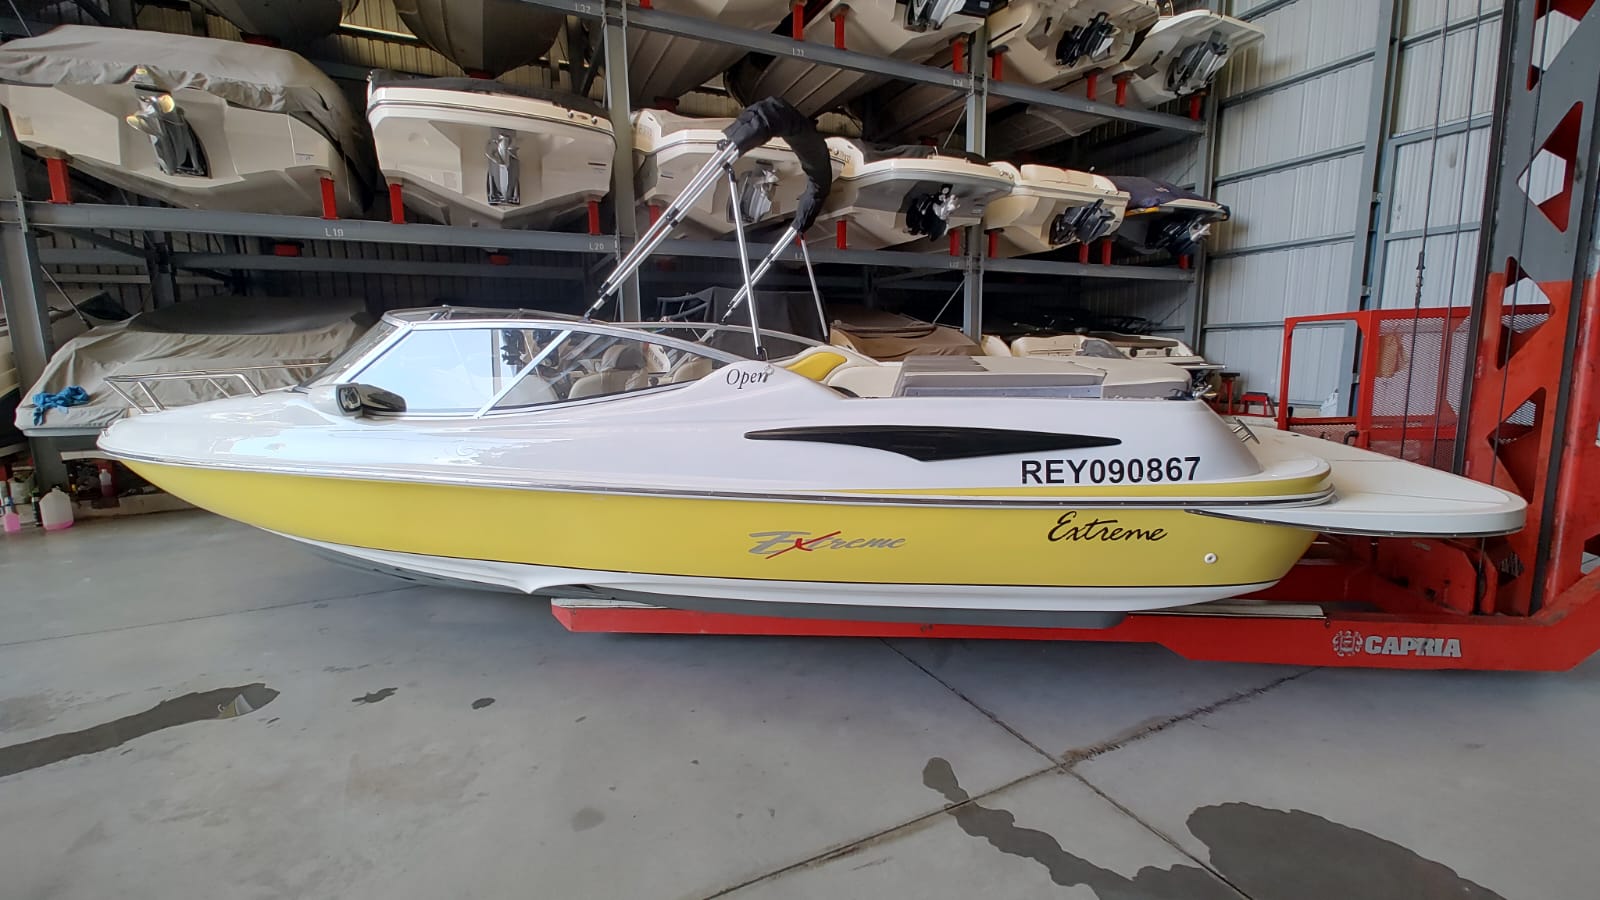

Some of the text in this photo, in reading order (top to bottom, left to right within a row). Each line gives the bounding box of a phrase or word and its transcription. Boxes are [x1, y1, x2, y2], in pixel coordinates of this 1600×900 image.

[726, 368, 769, 389] Open
[1021, 456, 1201, 485] REY090867
[1047, 510, 1168, 542] Extreme
[1364, 635, 1462, 658] CAPRIA
